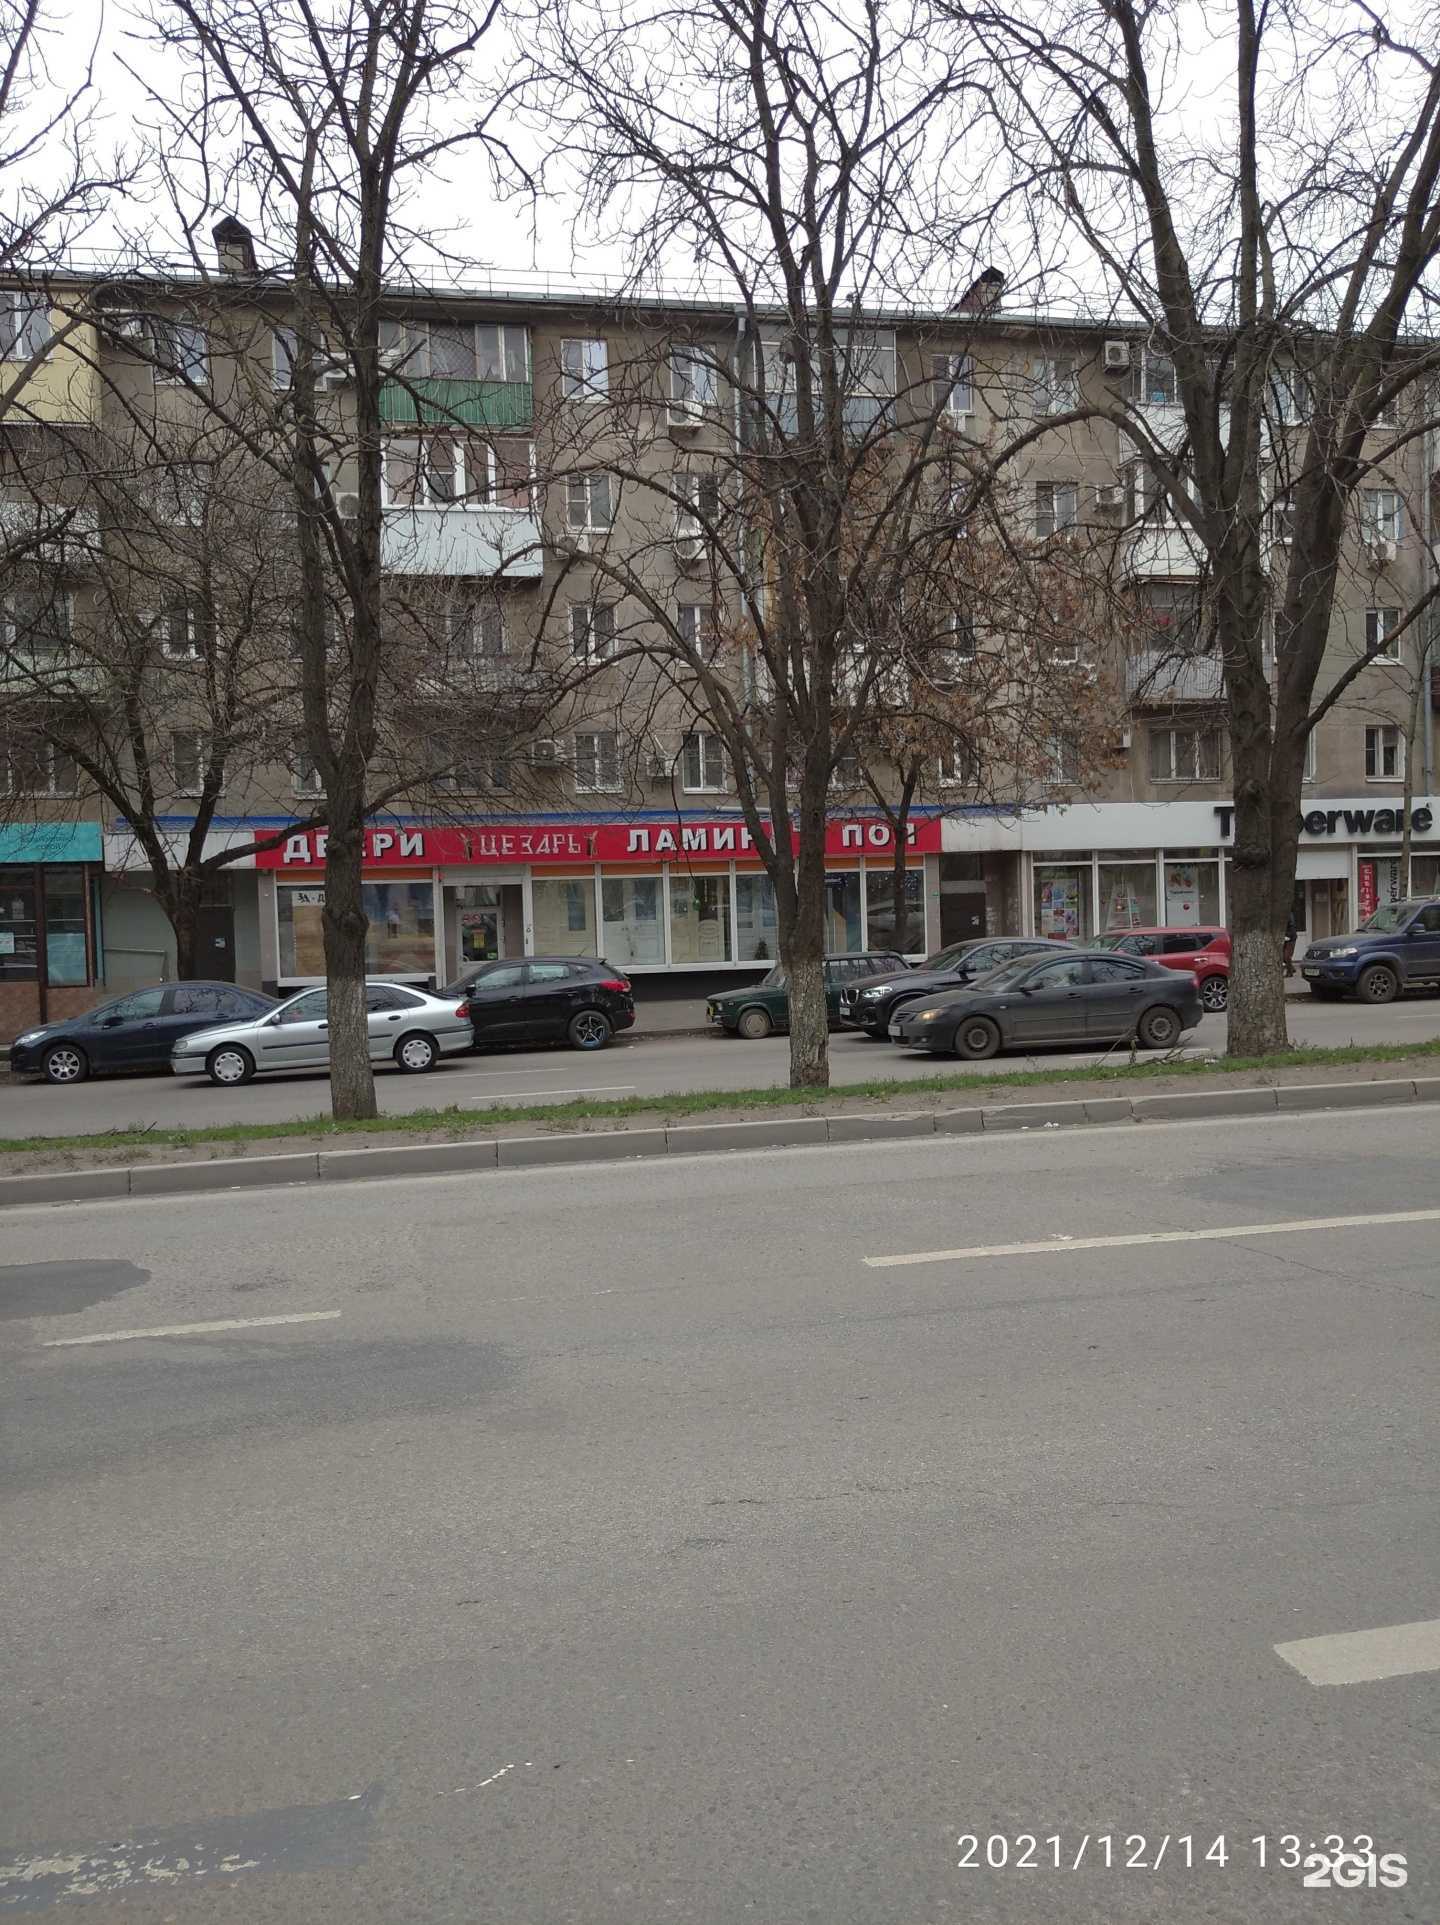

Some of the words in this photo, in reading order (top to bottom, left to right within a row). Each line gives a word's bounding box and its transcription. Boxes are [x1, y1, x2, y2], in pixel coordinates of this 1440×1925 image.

[1214, 804, 1433, 838] Terware
[283, 833, 424, 863] ДВРИ
[480, 833, 581, 856] ЦЕЗАРЬ
